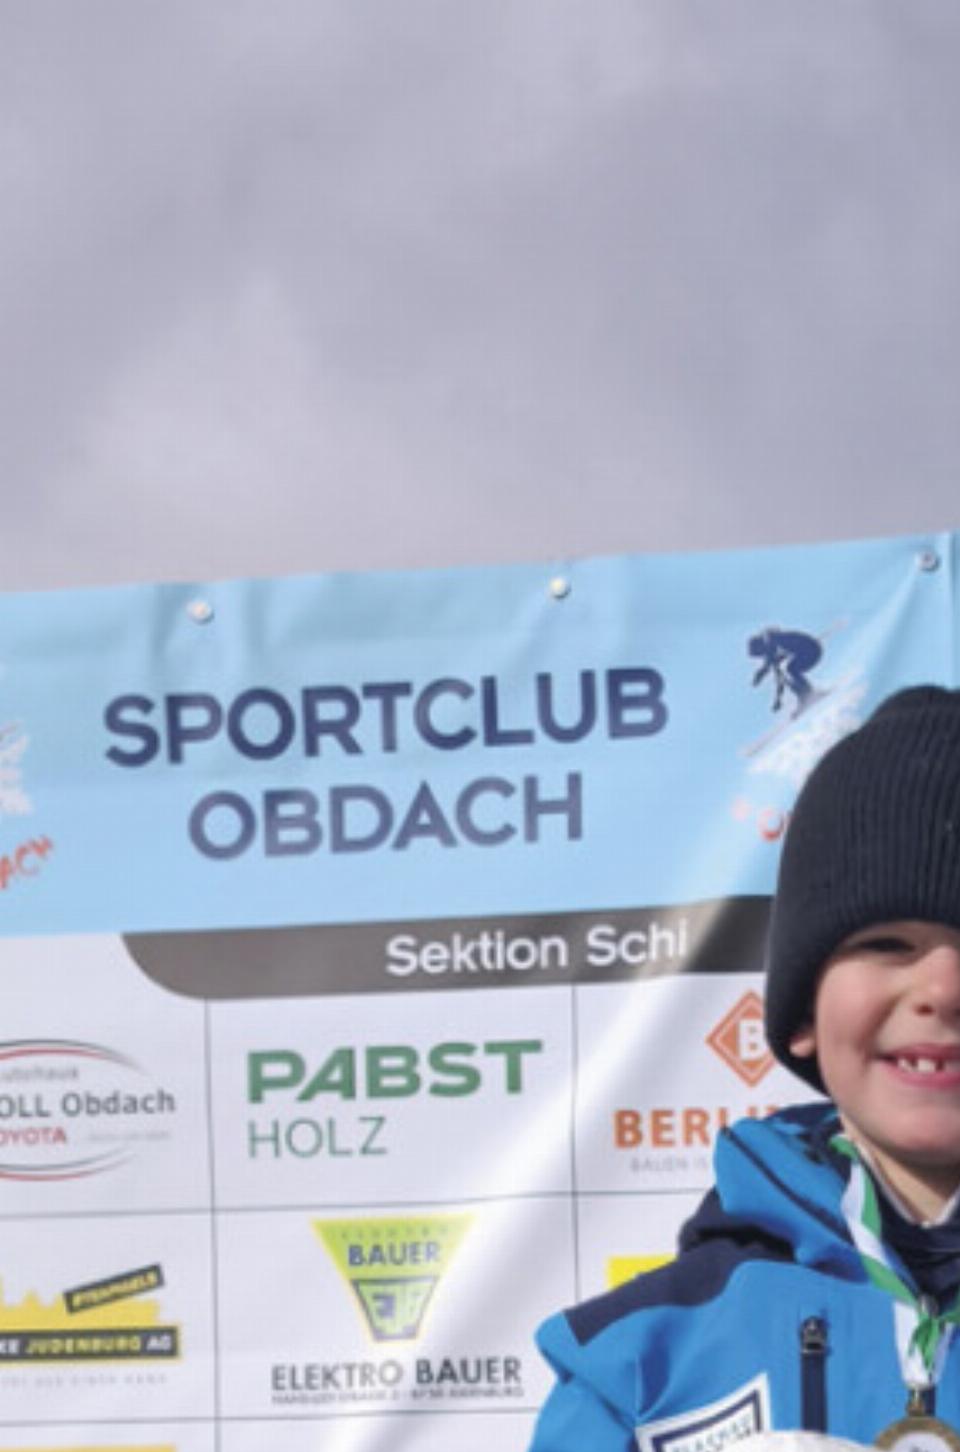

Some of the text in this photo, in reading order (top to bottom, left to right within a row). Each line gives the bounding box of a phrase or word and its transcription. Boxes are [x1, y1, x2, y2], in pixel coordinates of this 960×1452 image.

[103, 665, 669, 768] SPORTCLUB
[188, 771, 583, 861] OBDACH
[386, 918, 689, 975] Sektion Schi
[247, 1039, 545, 1105] PABST
[61, 1088, 176, 1117] Obdach
[248, 1116, 389, 1159] HOLZ
[348, 1242, 442, 1266] BAUER
[271, 1357, 523, 1392] ELEKTRO BAUER
